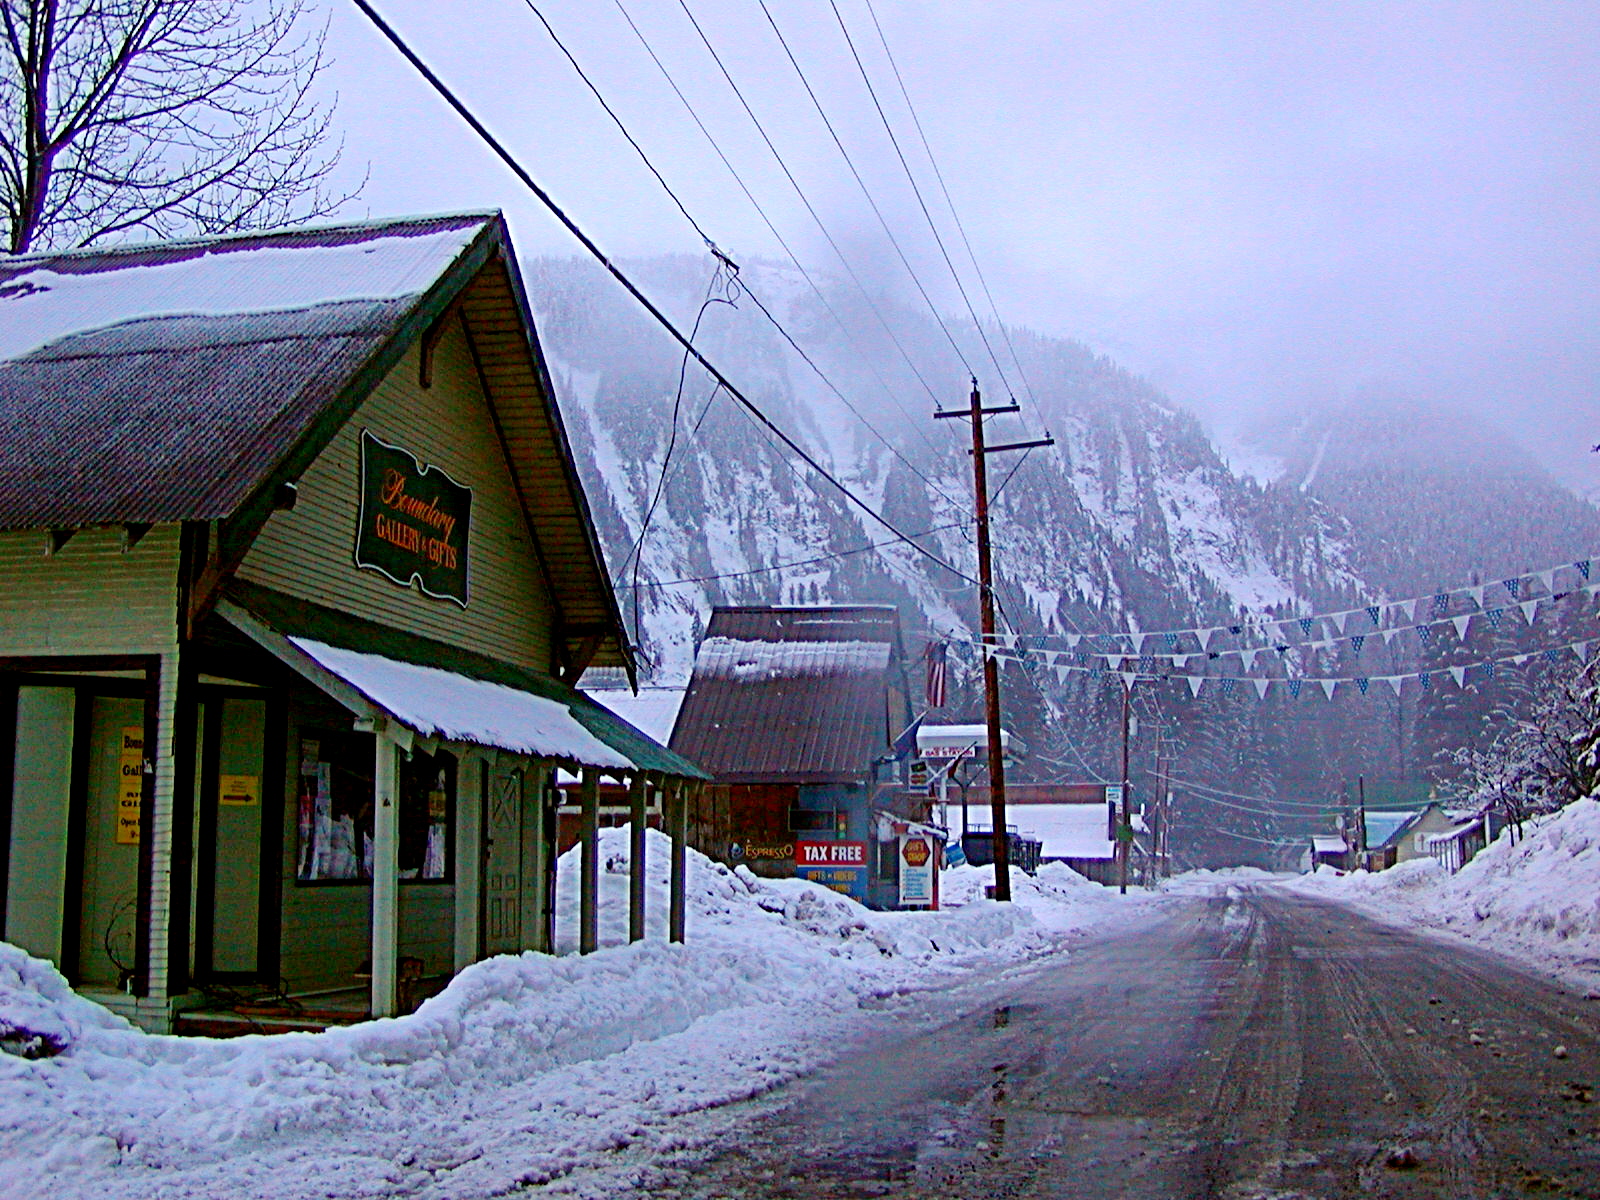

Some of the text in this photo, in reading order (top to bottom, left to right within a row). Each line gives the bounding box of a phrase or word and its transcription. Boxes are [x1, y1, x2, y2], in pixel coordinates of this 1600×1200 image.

[376, 513, 420, 554] GALLERY
[428, 537, 458, 569] GIFTS
[803, 845, 862, 861] TAX FREE
